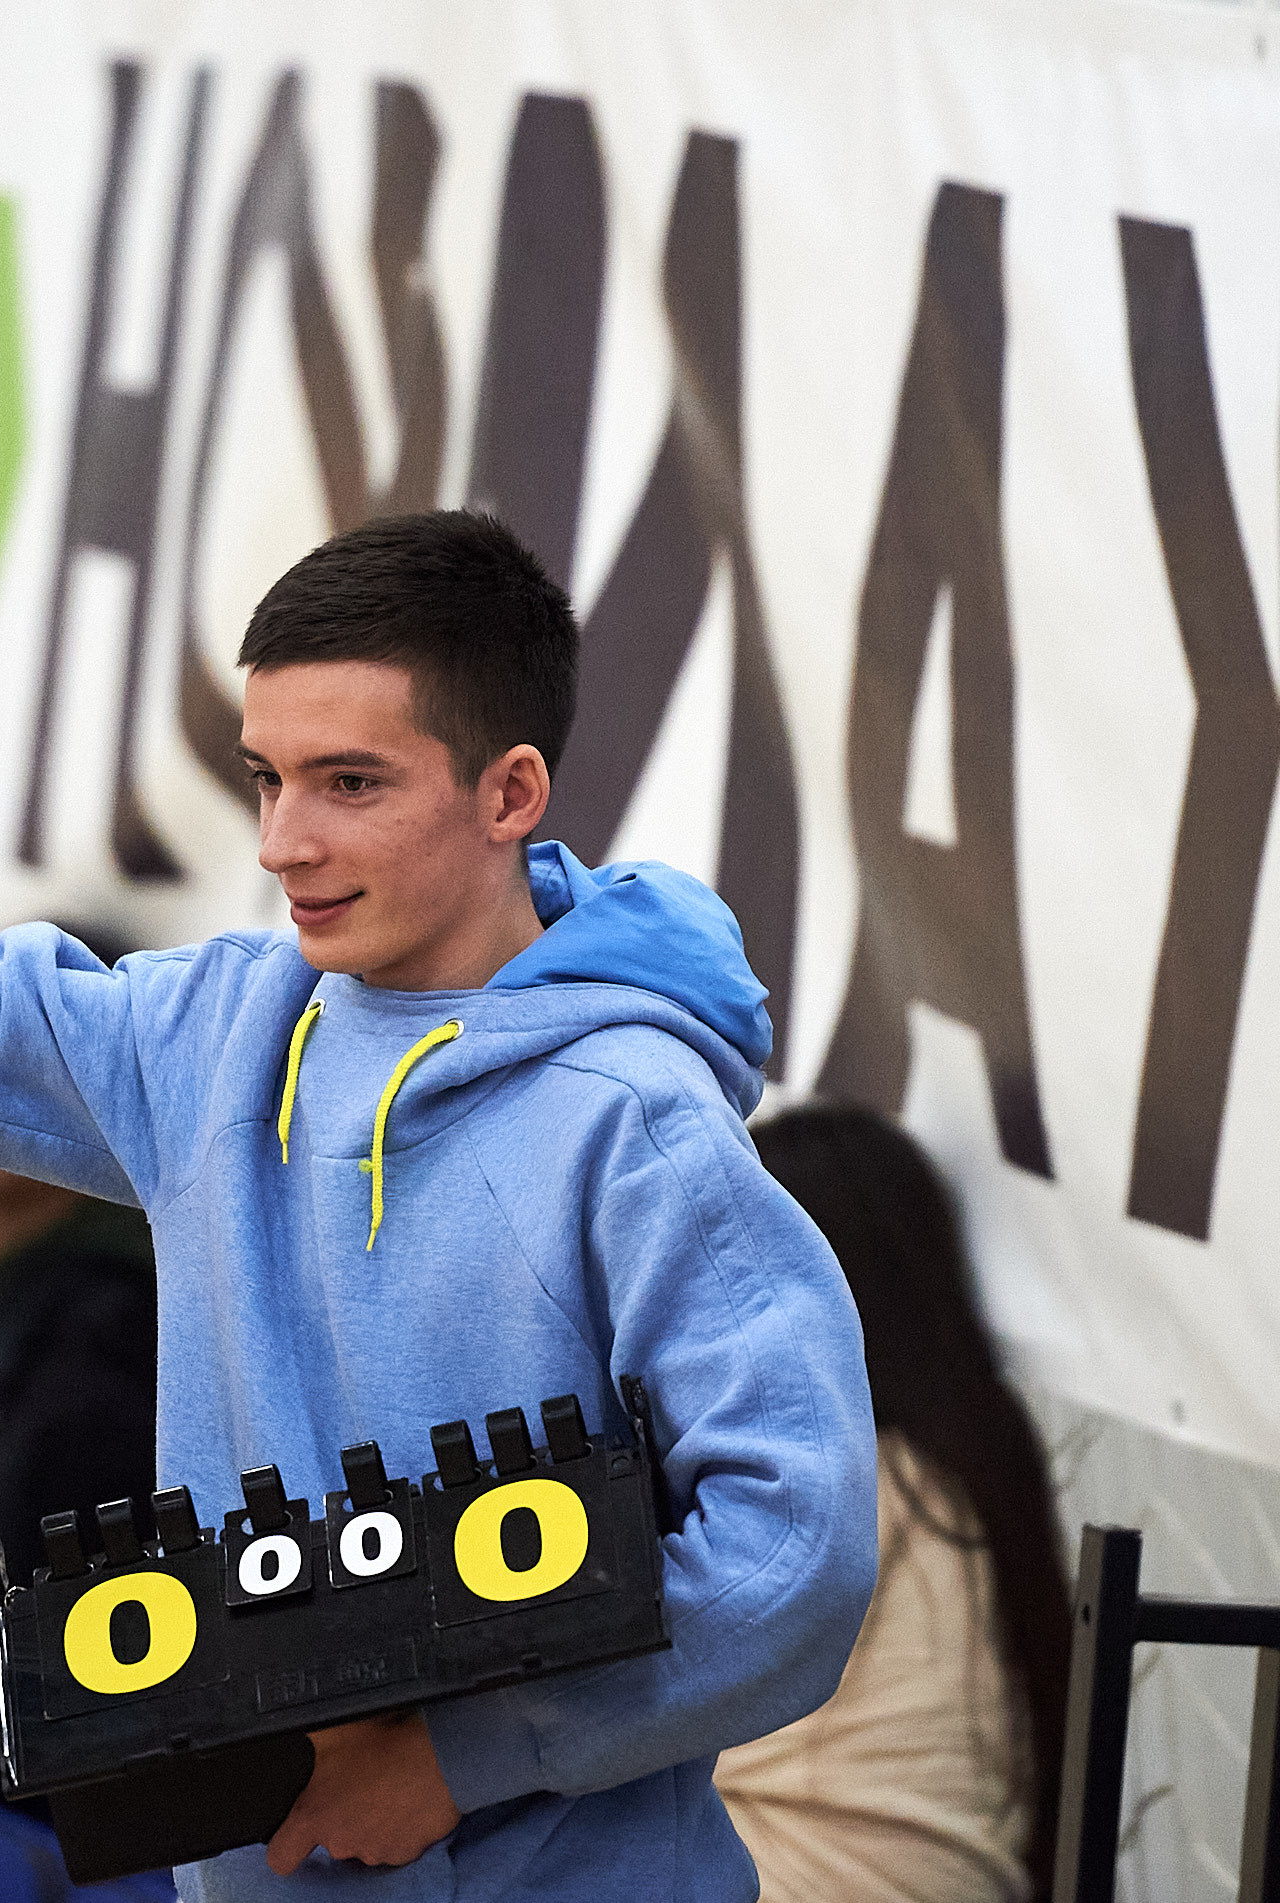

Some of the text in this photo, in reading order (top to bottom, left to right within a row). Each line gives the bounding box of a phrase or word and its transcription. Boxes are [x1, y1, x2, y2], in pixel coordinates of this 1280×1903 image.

[63, 1571, 197, 1695] 0
[238, 1535, 302, 1595] 0
[339, 1511, 403, 1577] 0
[453, 1478, 589, 1602] 0
